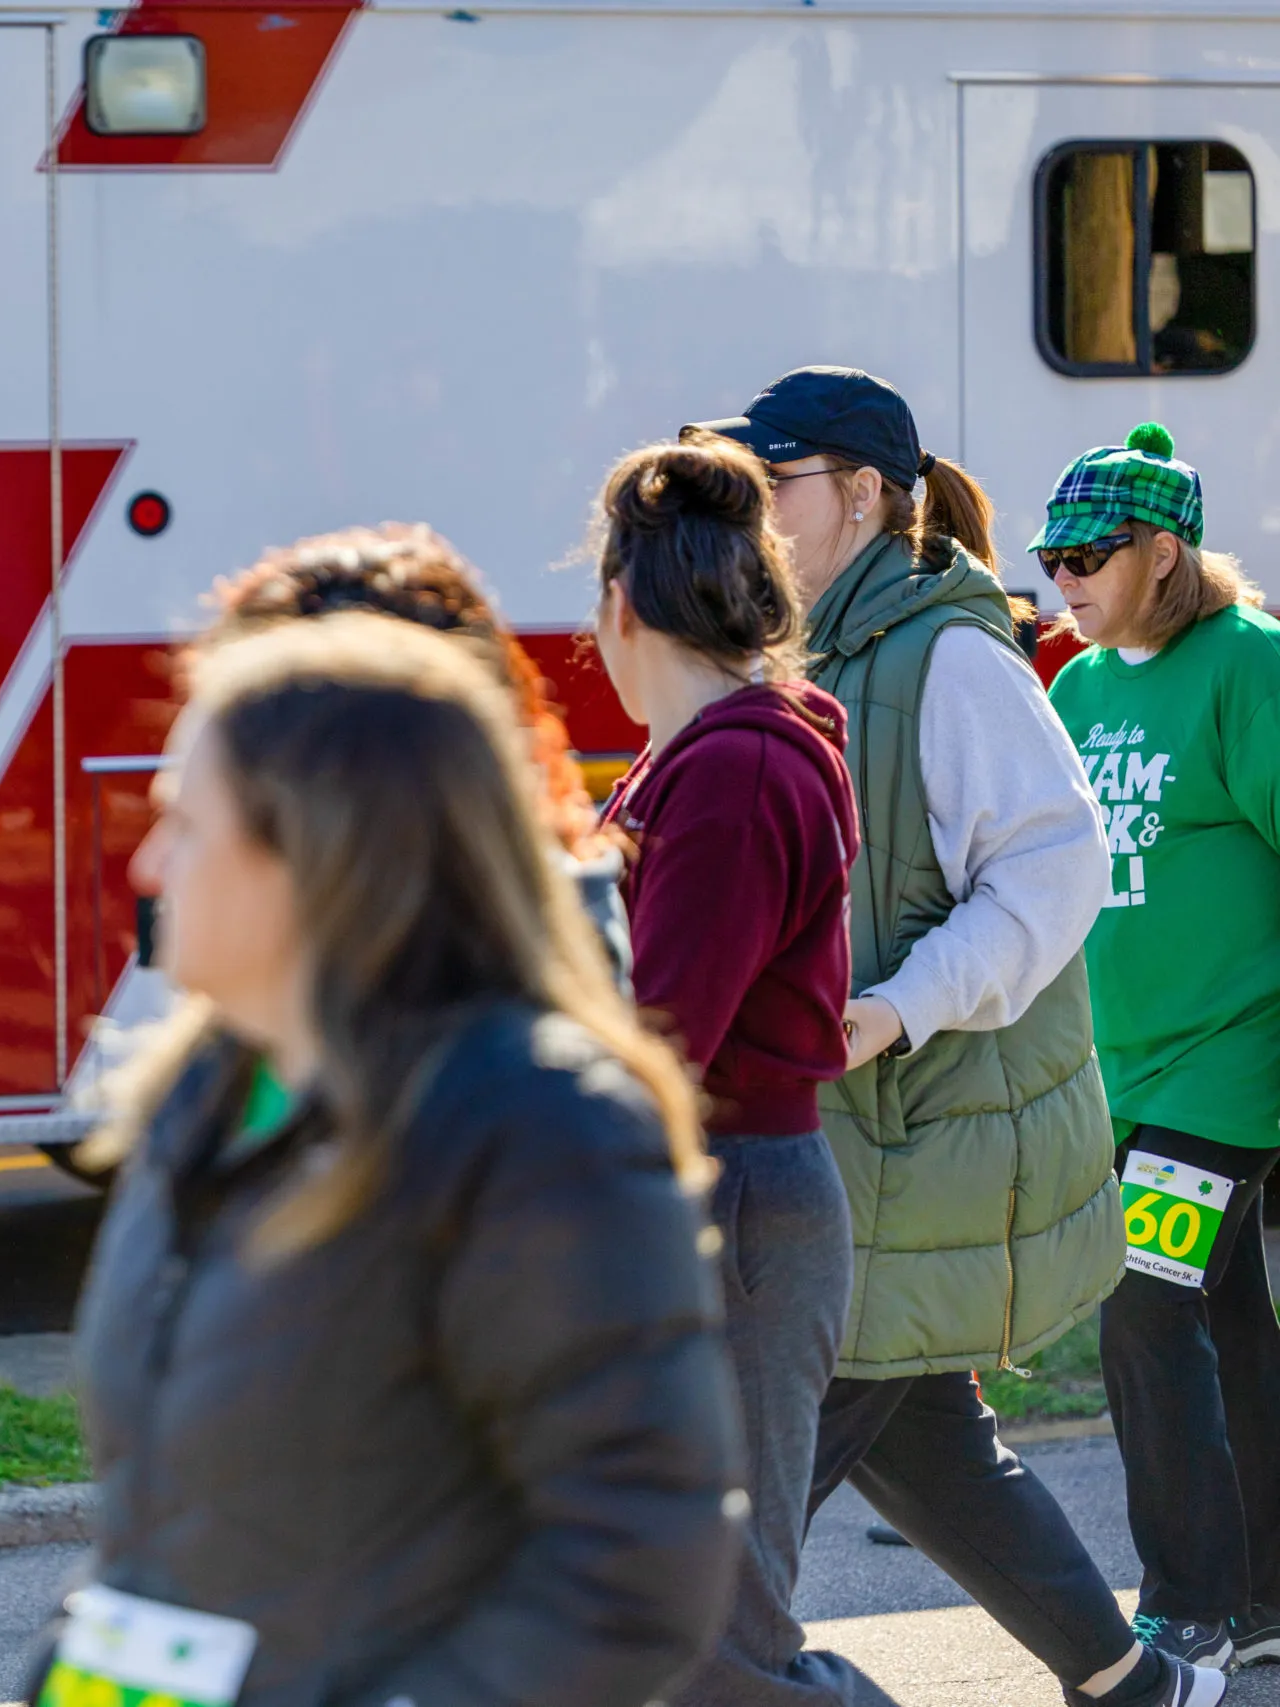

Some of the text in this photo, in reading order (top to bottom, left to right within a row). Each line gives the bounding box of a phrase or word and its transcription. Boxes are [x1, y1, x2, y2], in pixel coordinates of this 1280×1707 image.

[768, 441, 797, 450] DRI-FIT
[1080, 719, 1145, 753] Ready to
[1100, 804, 1165, 854] K &
[1120, 1186, 1201, 1258] 60
[1152, 1261, 1181, 1277] Cancer
[1181, 1271, 1192, 1281] 5K
